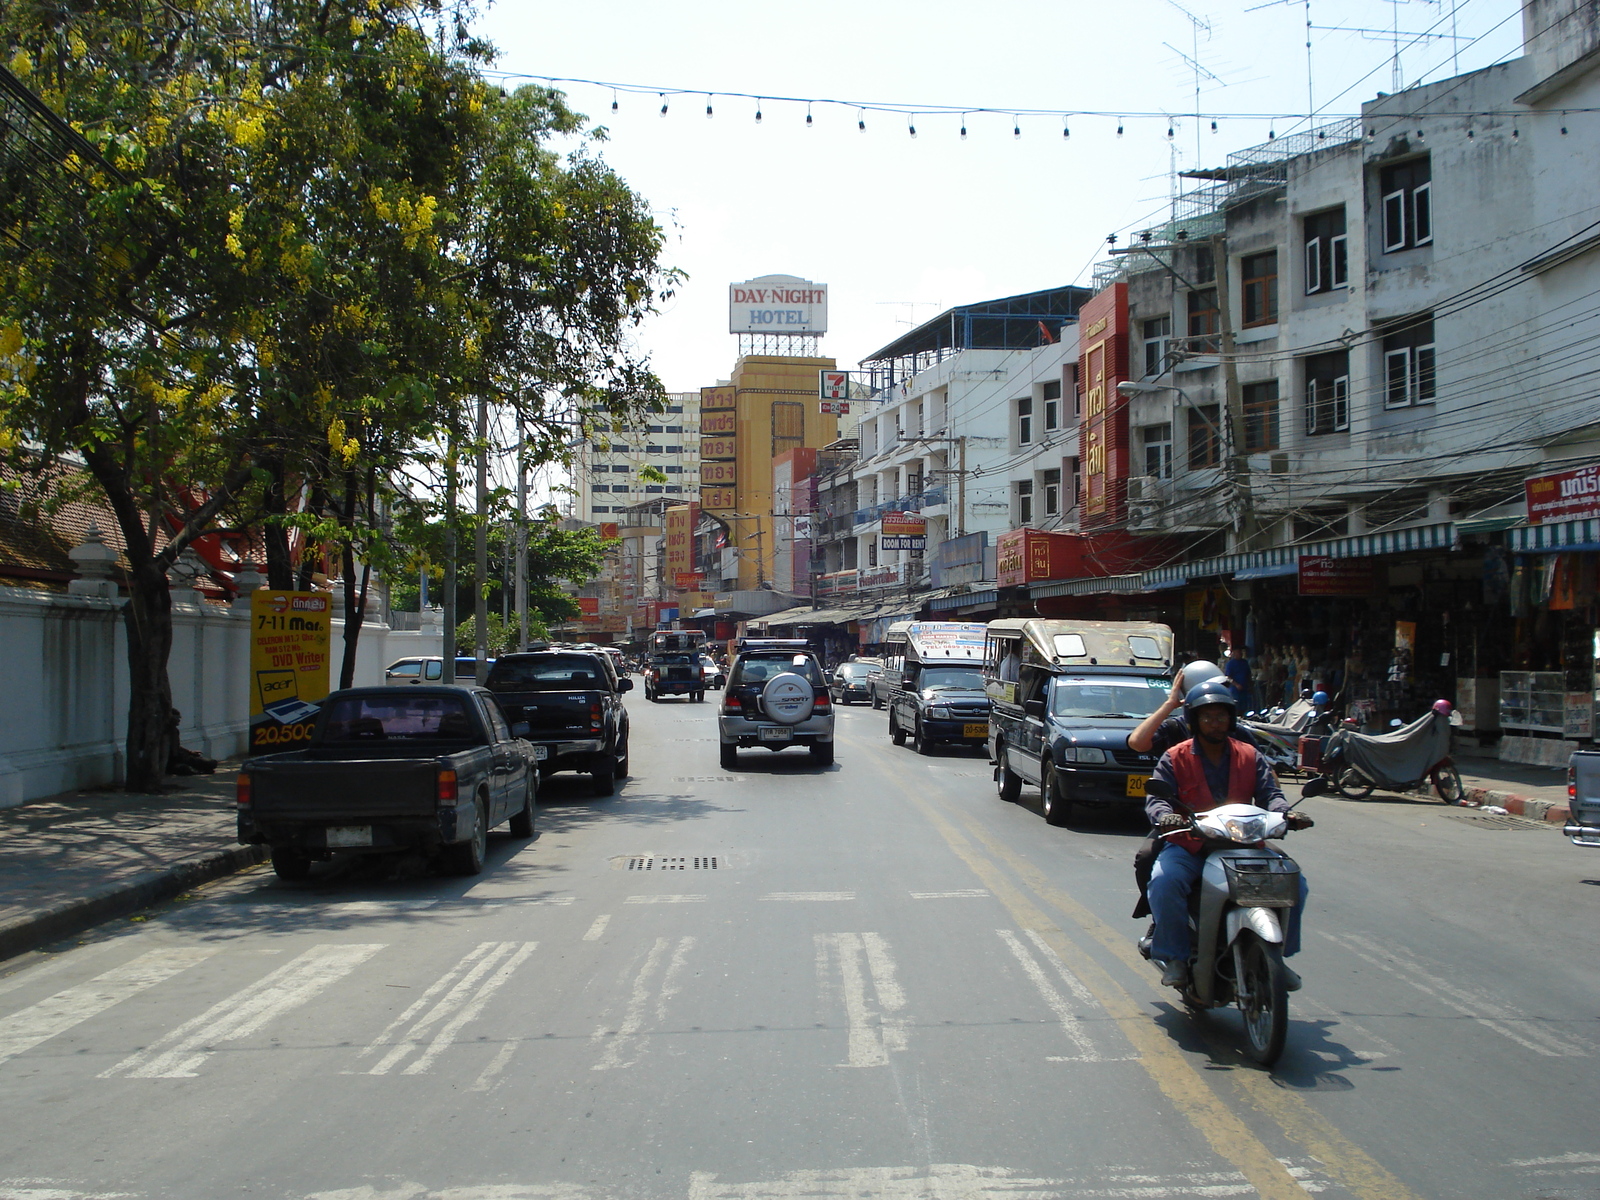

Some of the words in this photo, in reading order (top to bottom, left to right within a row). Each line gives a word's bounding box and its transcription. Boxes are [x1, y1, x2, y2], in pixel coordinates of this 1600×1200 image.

[733, 288, 825, 304] DAY-NIGHT
[750, 310, 810, 325] HOTEL
[827, 374, 844, 398] 7
[705, 388, 733, 407] ห้าง
[831, 404, 840, 412] 24
[703, 415, 734, 431] เพชร
[703, 441, 734, 455] ทอง
[703, 466, 734, 480] ทอง
[1560, 467, 1600, 498] มณีรั
[883, 539, 900, 549] ROOM
[900, 539, 911, 549] FOR
[912, 539, 925, 549] RENT
[258, 615, 285, 630] 7-11
[289, 617, 324, 632] Mar.
[257, 636, 284, 646] CELERON
[265, 646, 278, 654] RAM
[279, 645, 291, 653] 512
[272, 654, 294, 667] DVD
[295, 652, 325, 664] Writer
[263, 679, 293, 691] acer
